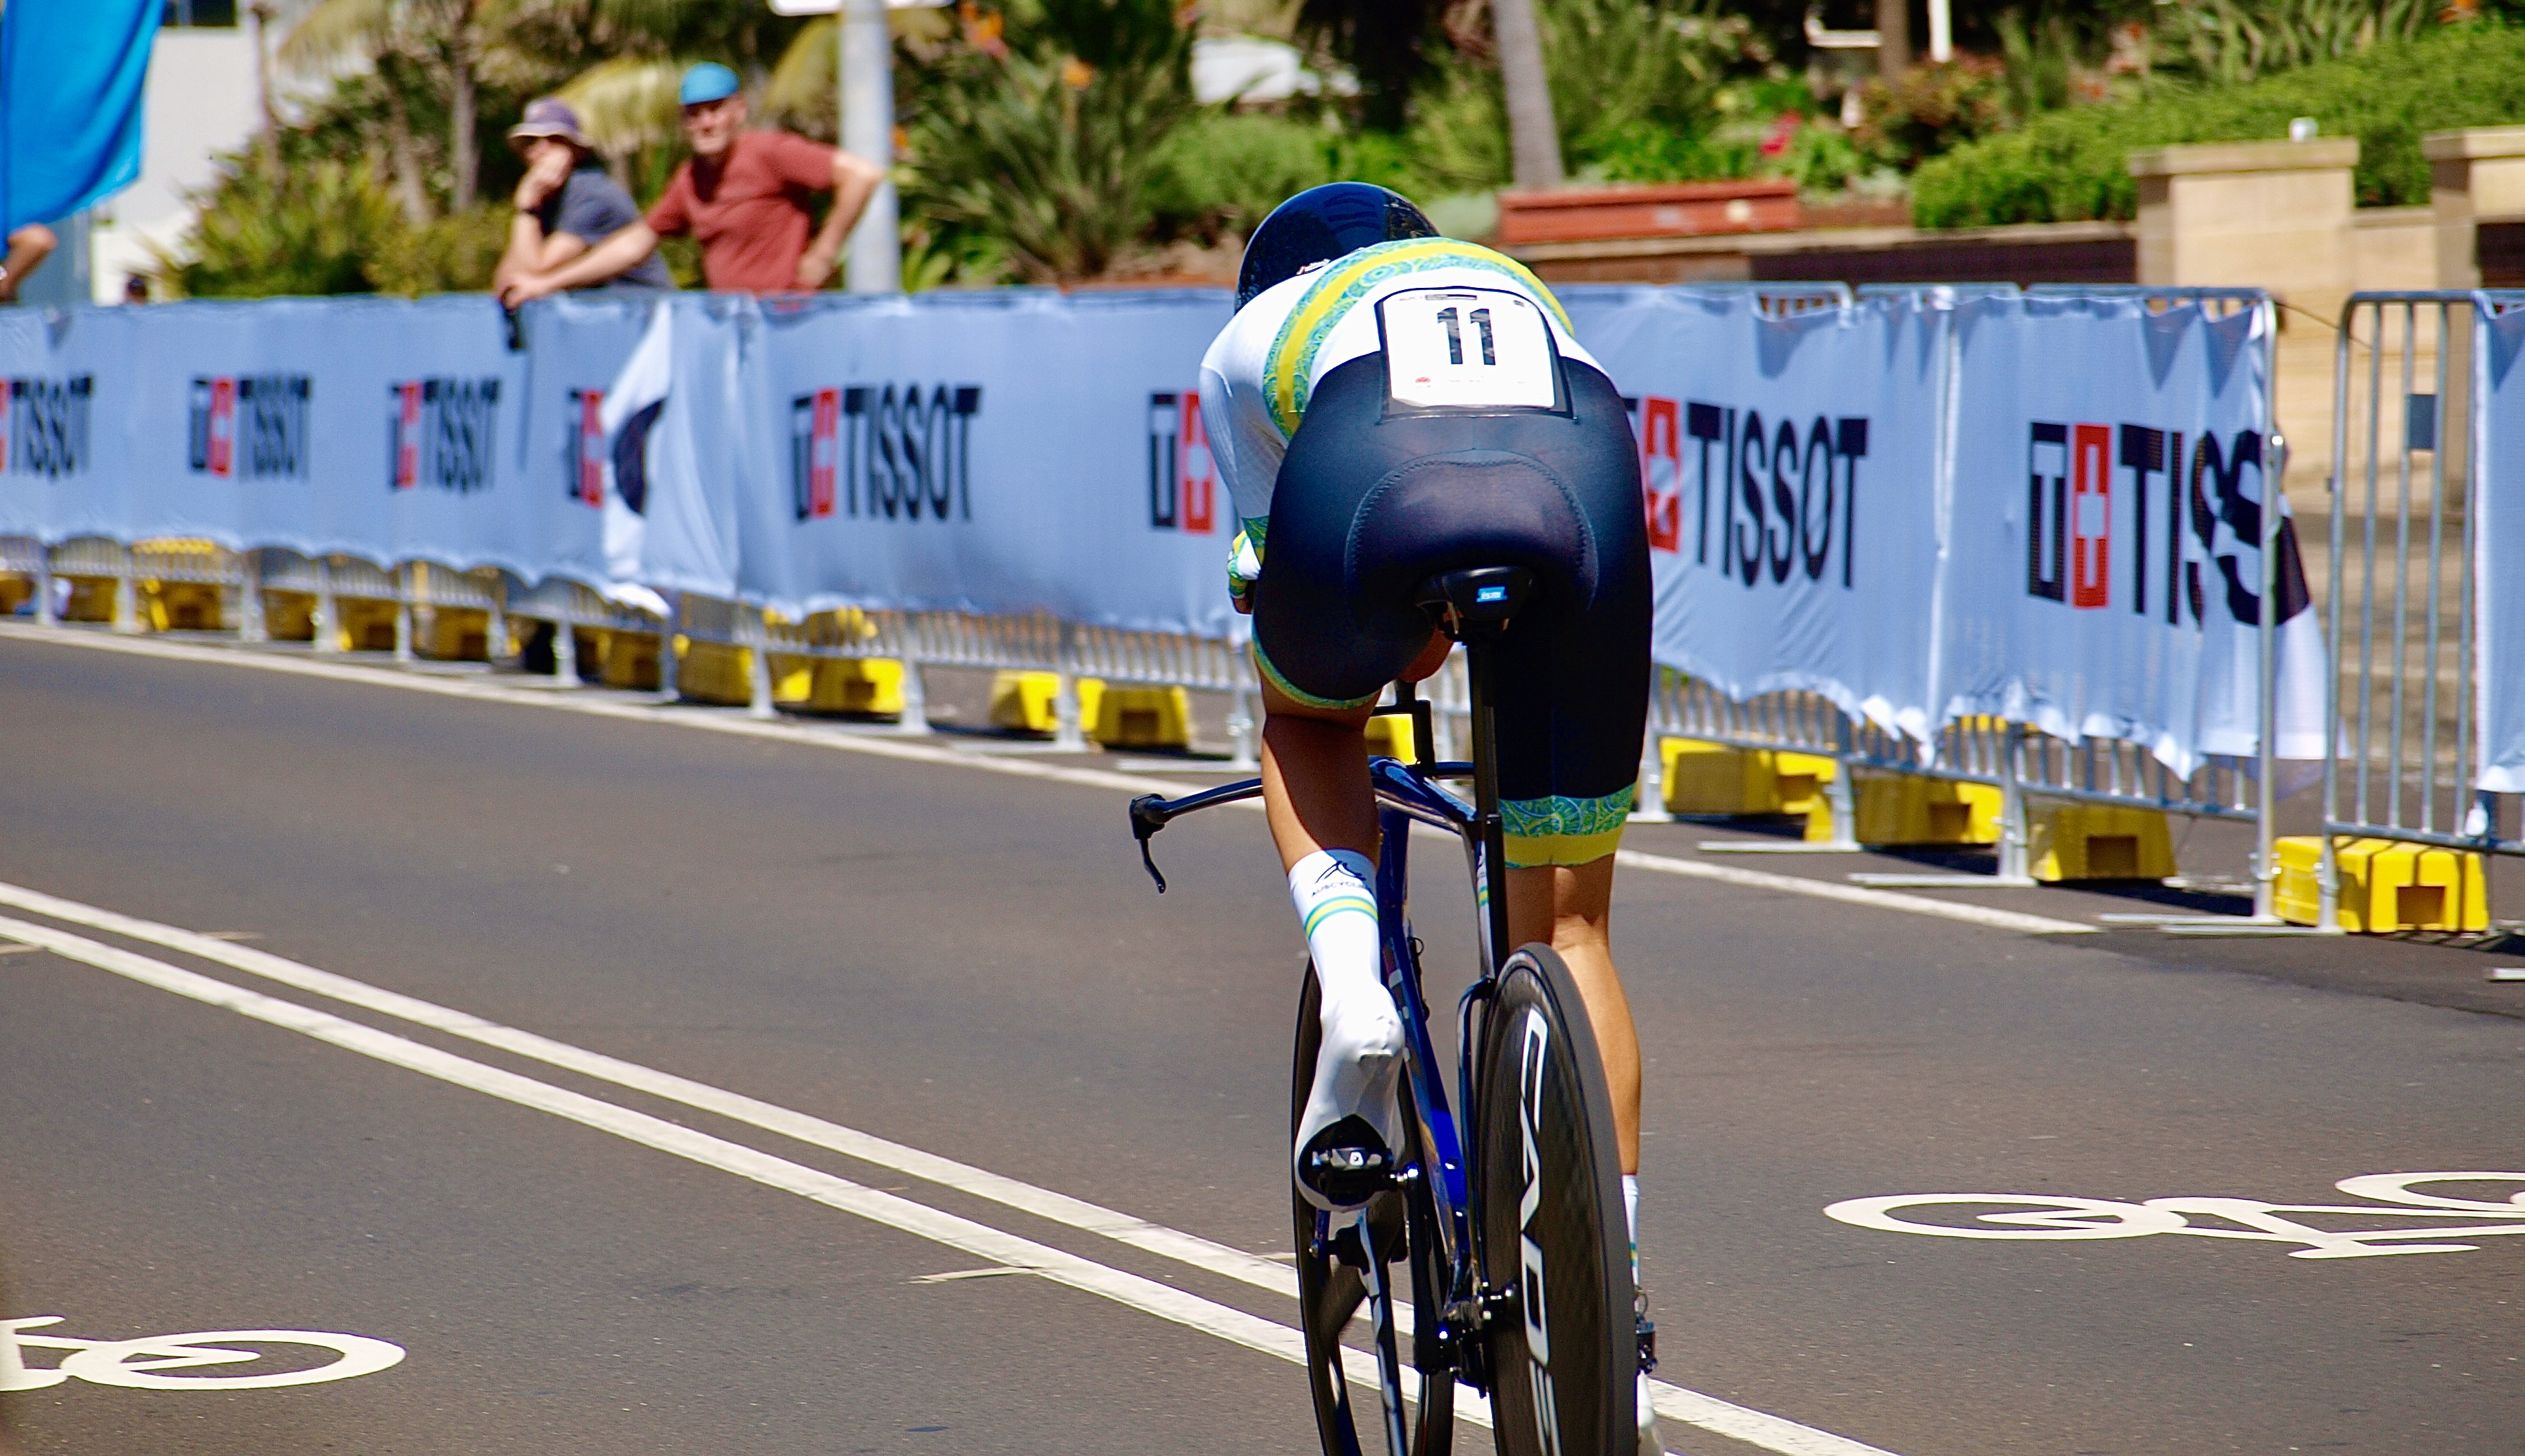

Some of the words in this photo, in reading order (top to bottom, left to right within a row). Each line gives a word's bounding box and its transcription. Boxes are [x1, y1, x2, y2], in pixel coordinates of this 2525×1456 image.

[1437, 307, 1496, 365] 11
[845, 383, 981, 522] TISSOT
[1687, 401, 1867, 589] TISSOT
